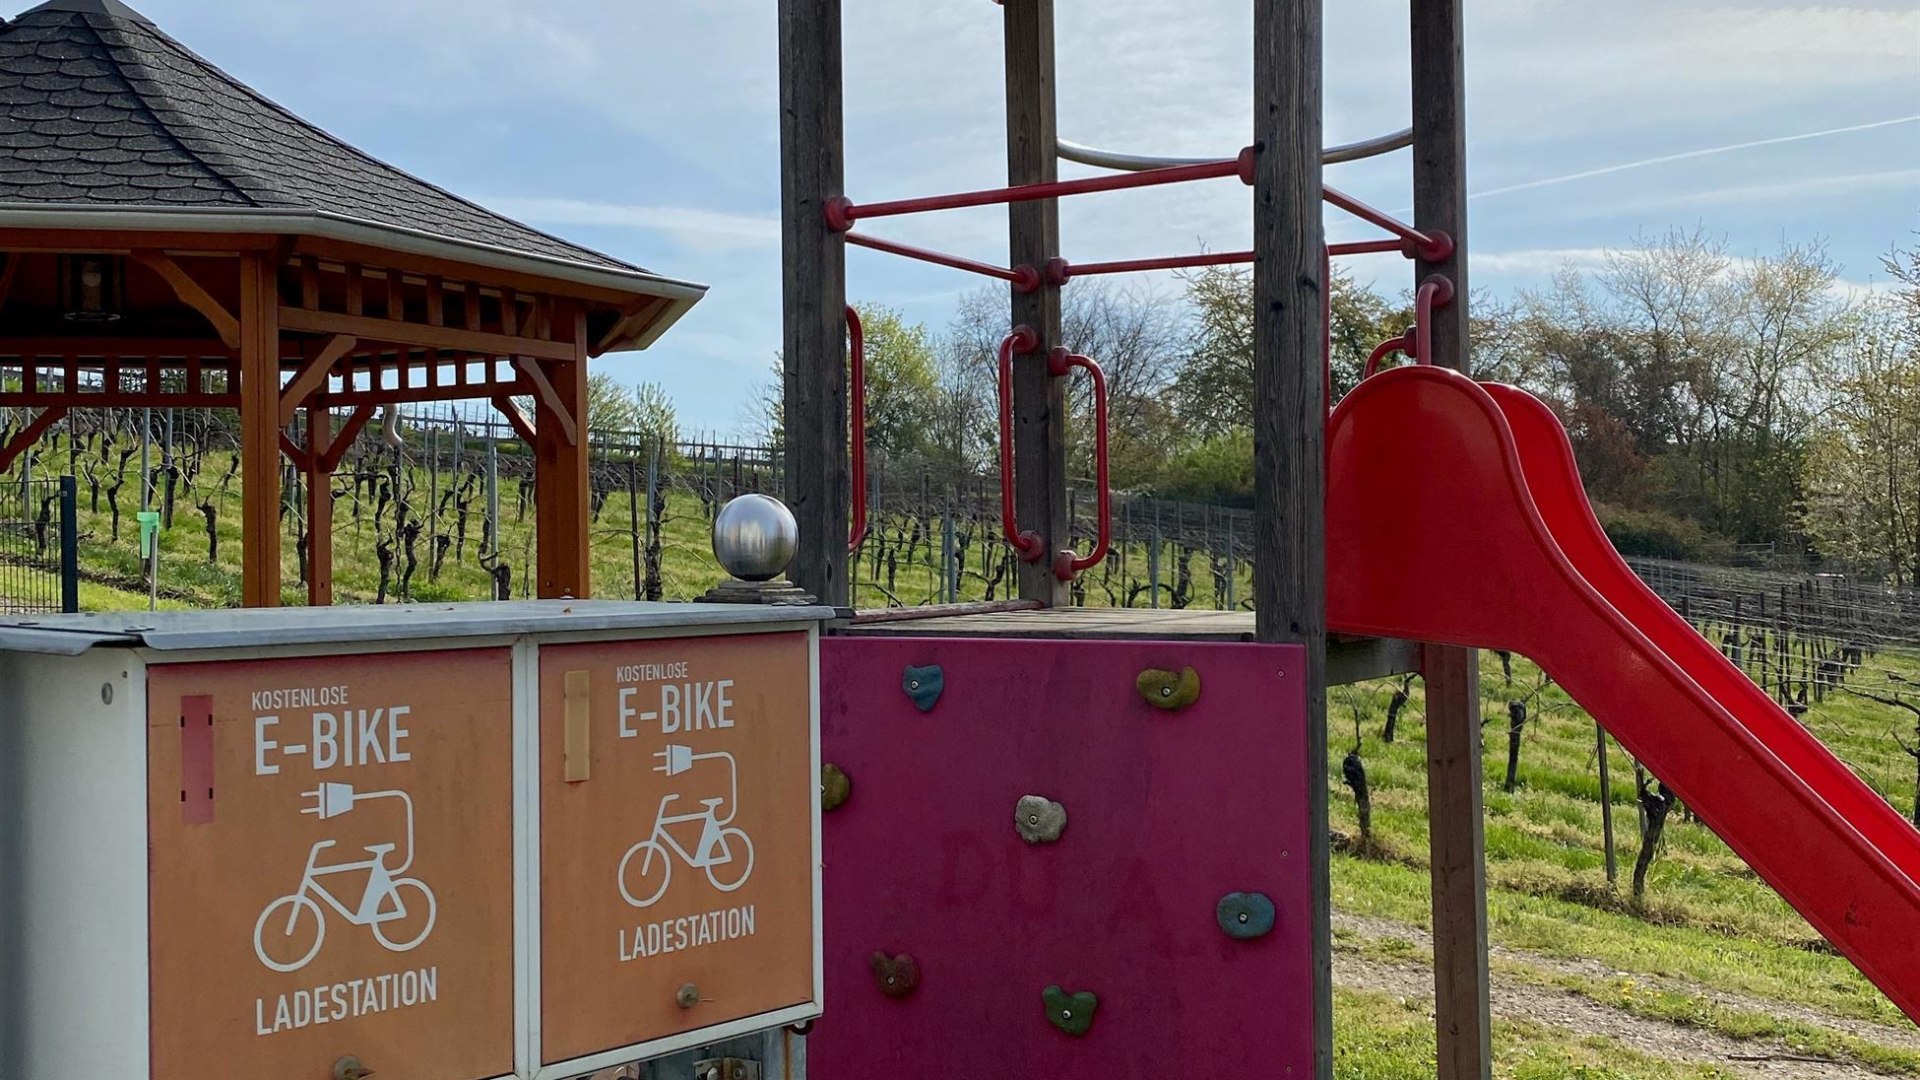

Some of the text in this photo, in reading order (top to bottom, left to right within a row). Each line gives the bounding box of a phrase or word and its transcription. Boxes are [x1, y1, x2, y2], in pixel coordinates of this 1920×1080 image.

[252, 685, 349, 711] KOSTENLOSE
[616, 661, 688, 683] KOSTENLOSE
[618, 679, 735, 738] E-BIKE
[255, 705, 412, 776] E-BIKE
[618, 904, 756, 962] LADESTATION
[256, 965, 437, 1036] LADESTATION
